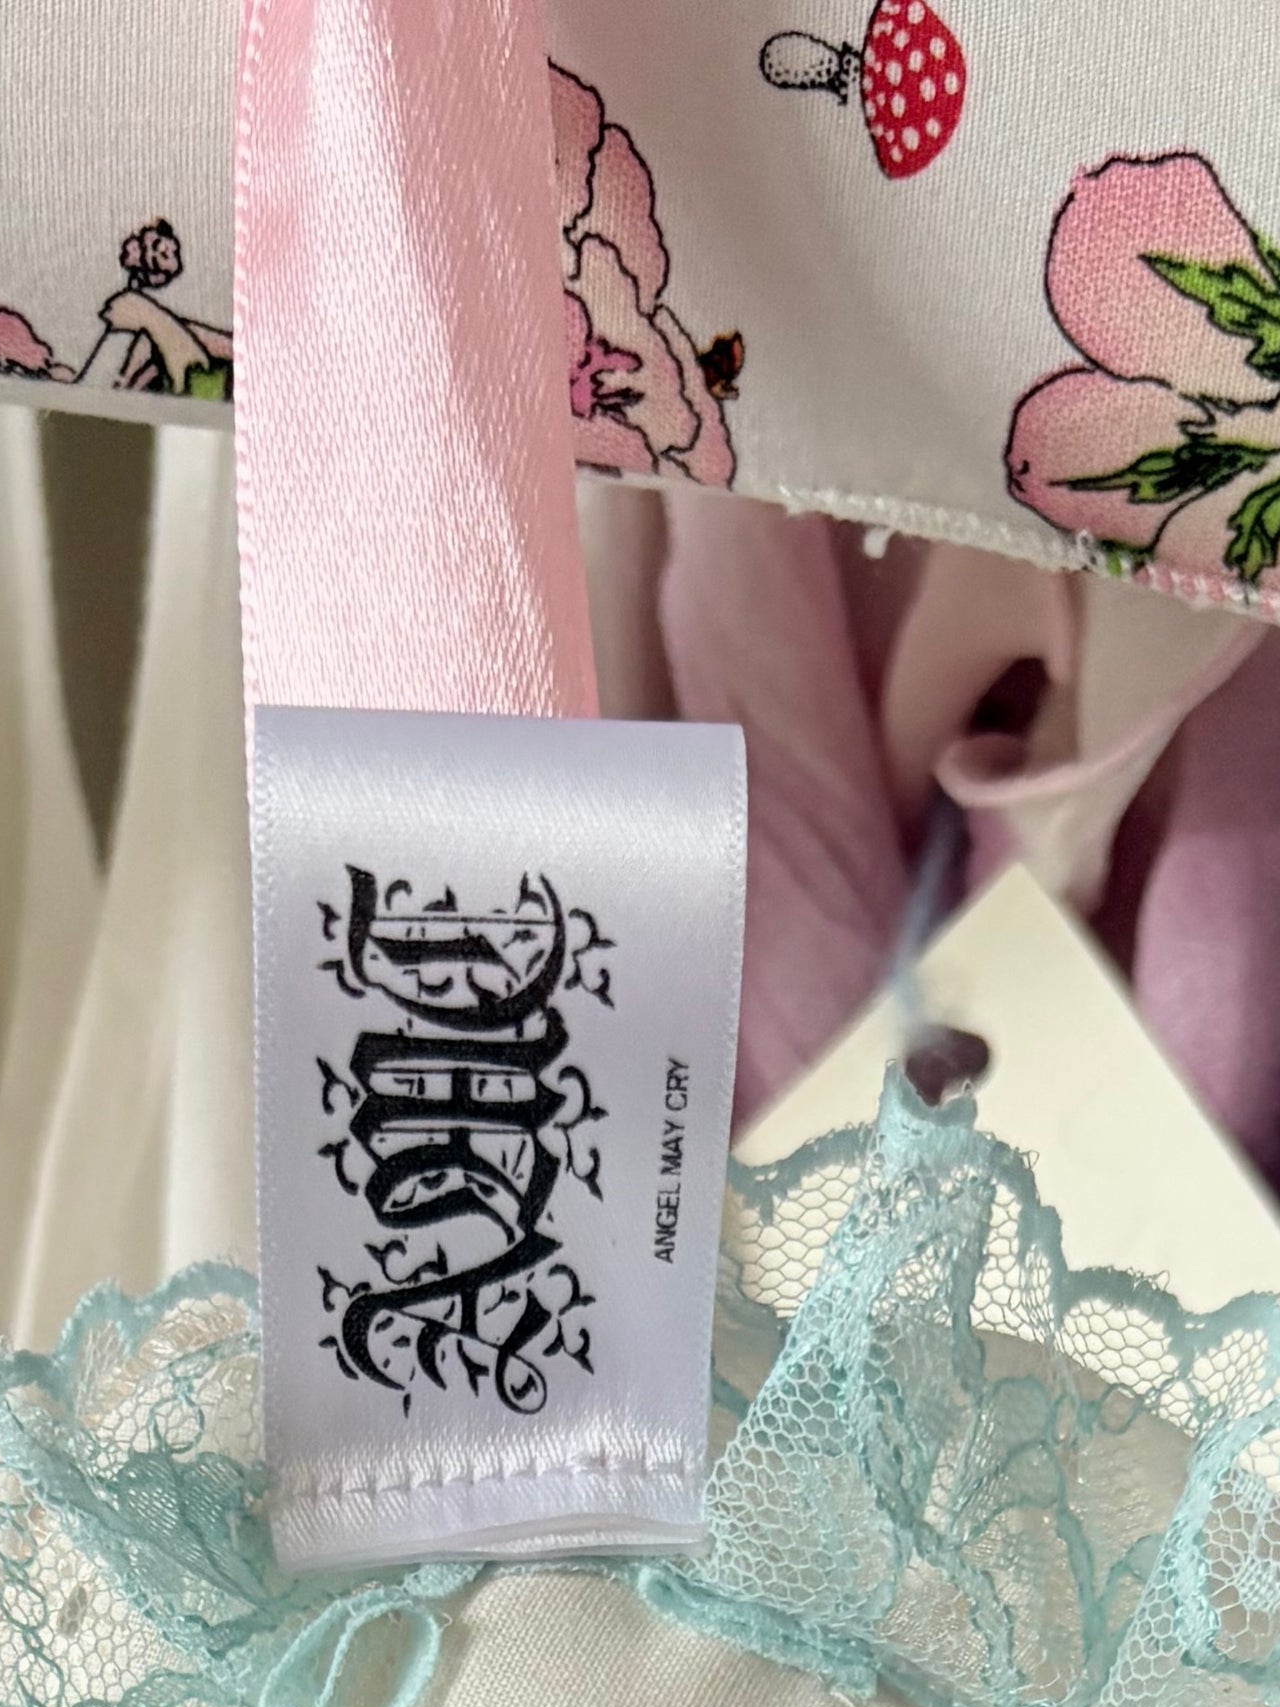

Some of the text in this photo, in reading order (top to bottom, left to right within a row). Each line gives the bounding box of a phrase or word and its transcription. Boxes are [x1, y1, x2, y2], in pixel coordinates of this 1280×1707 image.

[653, 1056, 690, 1265] ANGEL MAY CRY
